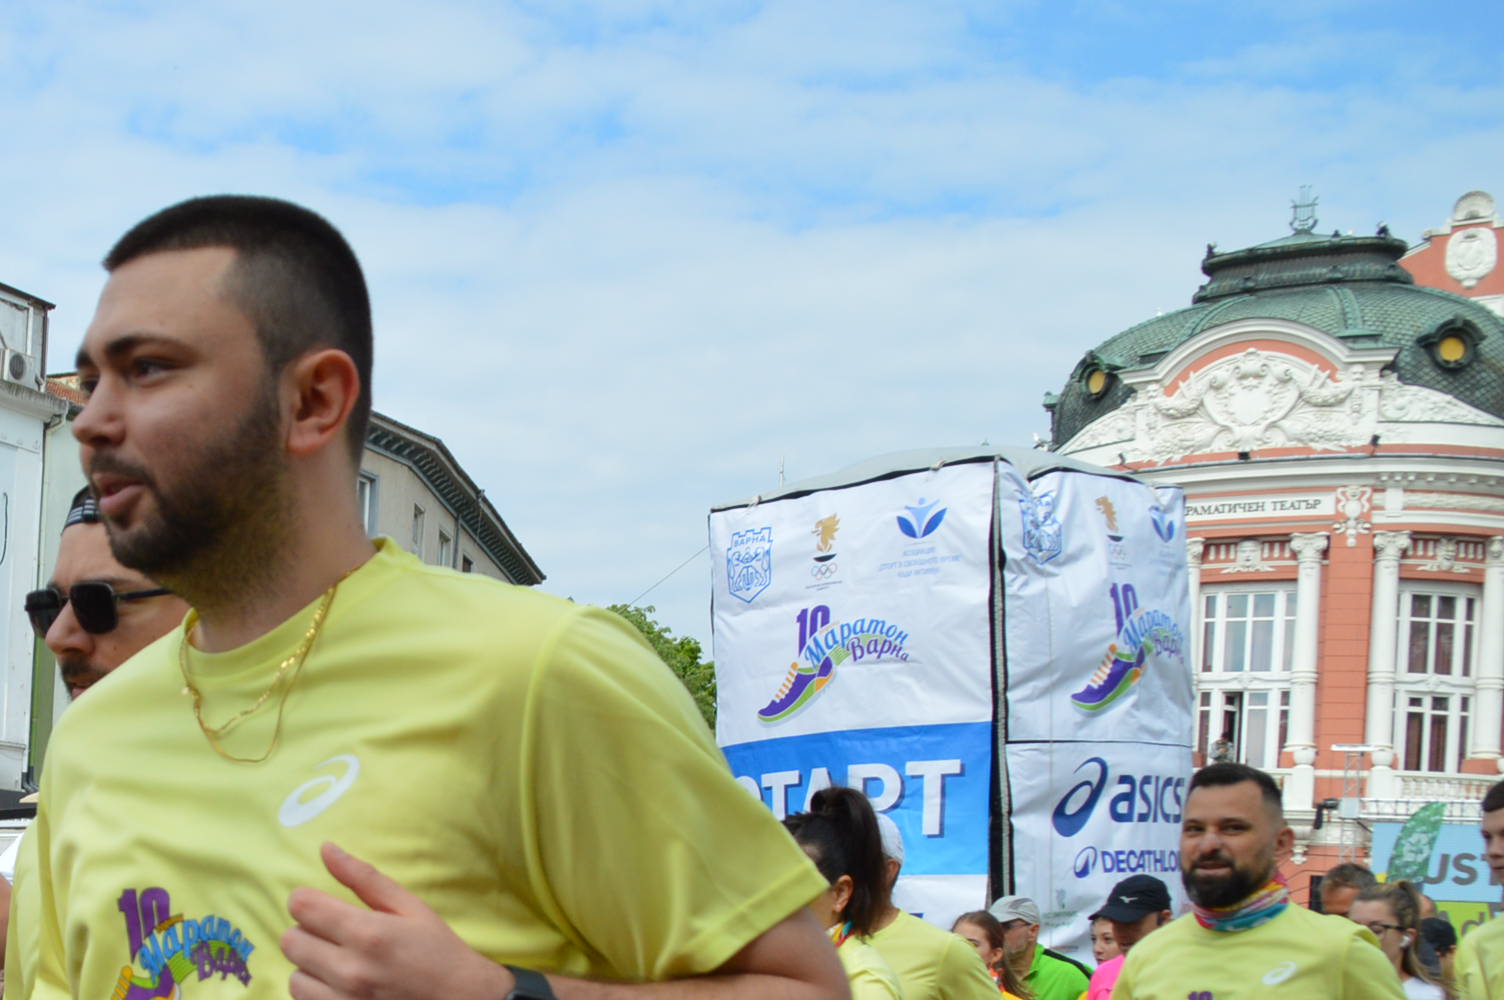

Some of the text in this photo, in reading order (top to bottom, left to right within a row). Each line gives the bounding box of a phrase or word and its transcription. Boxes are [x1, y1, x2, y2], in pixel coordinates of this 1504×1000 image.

[1184, 499, 1321, 516] РАМАТИЧЕН ТЕАТЪР
[796, 604, 831, 657] 10
[804, 617, 910, 668] Маратон
[845, 636, 910, 663] Варна
[1109, 775, 1185, 824] asics
[1101, 850, 1181, 873] DECATHLO
[117, 886, 170, 964] 10
